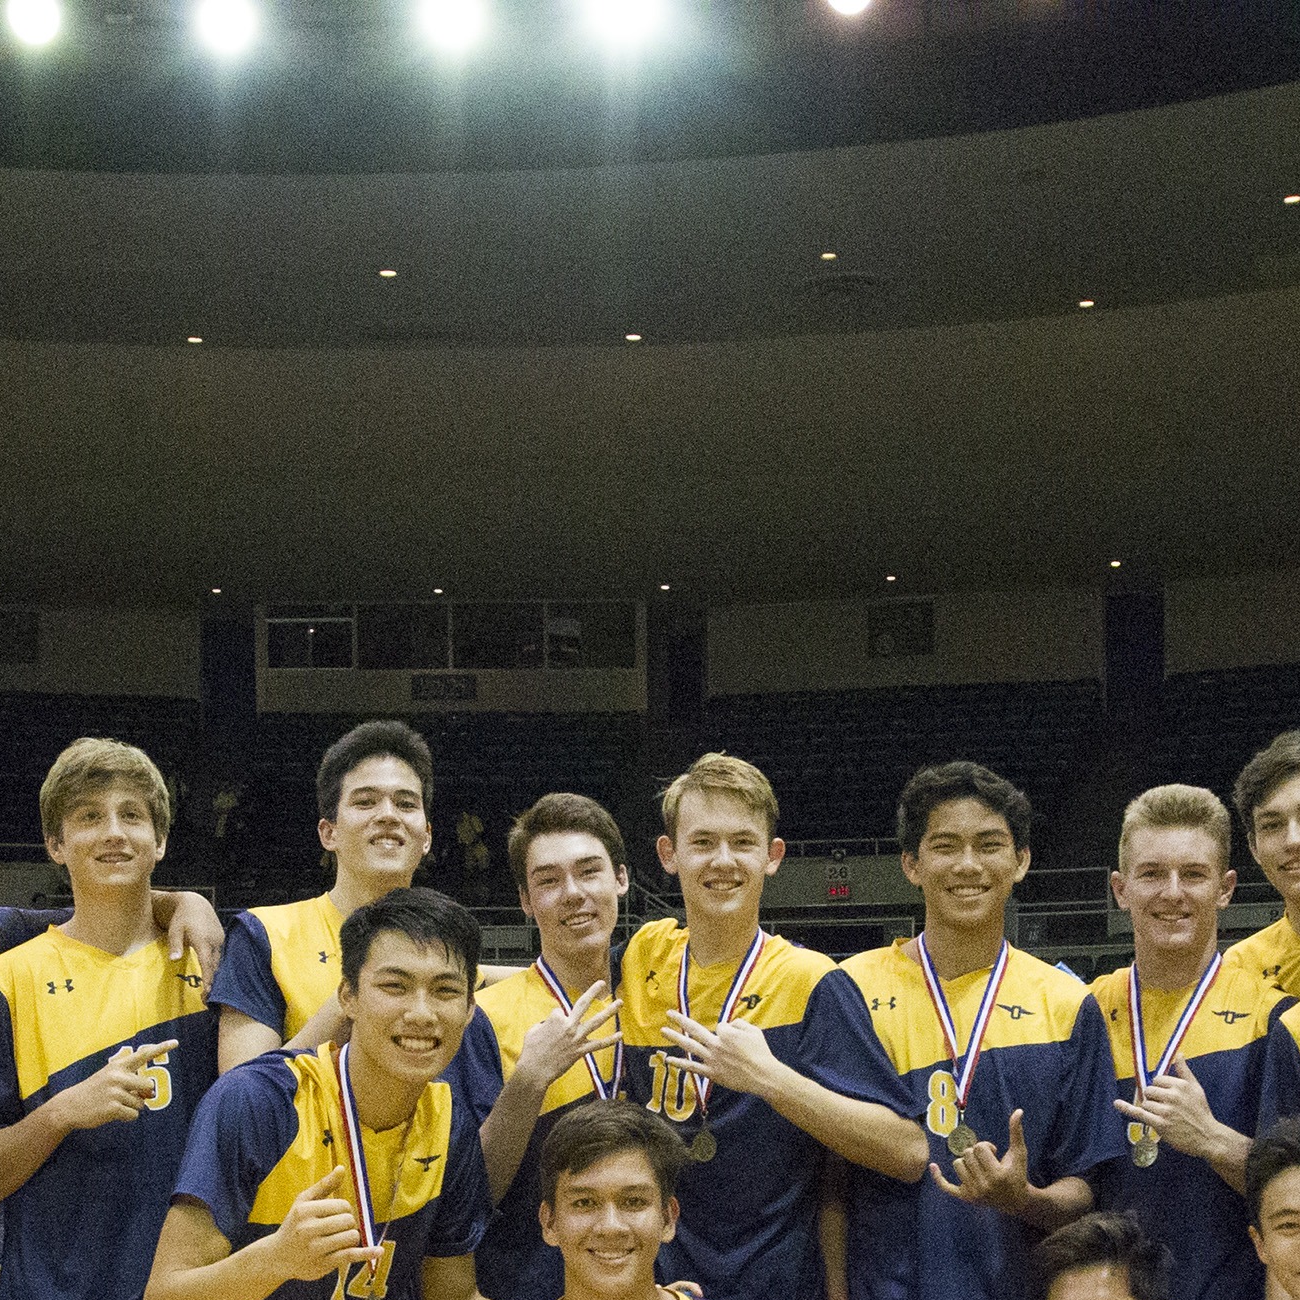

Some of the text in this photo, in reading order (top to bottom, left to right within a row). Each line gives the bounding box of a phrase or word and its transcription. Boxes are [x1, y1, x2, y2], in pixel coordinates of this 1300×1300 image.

[828, 866, 849, 880] 26
[646, 1050, 698, 1122] 10
[926, 1069, 960, 1139] 8
